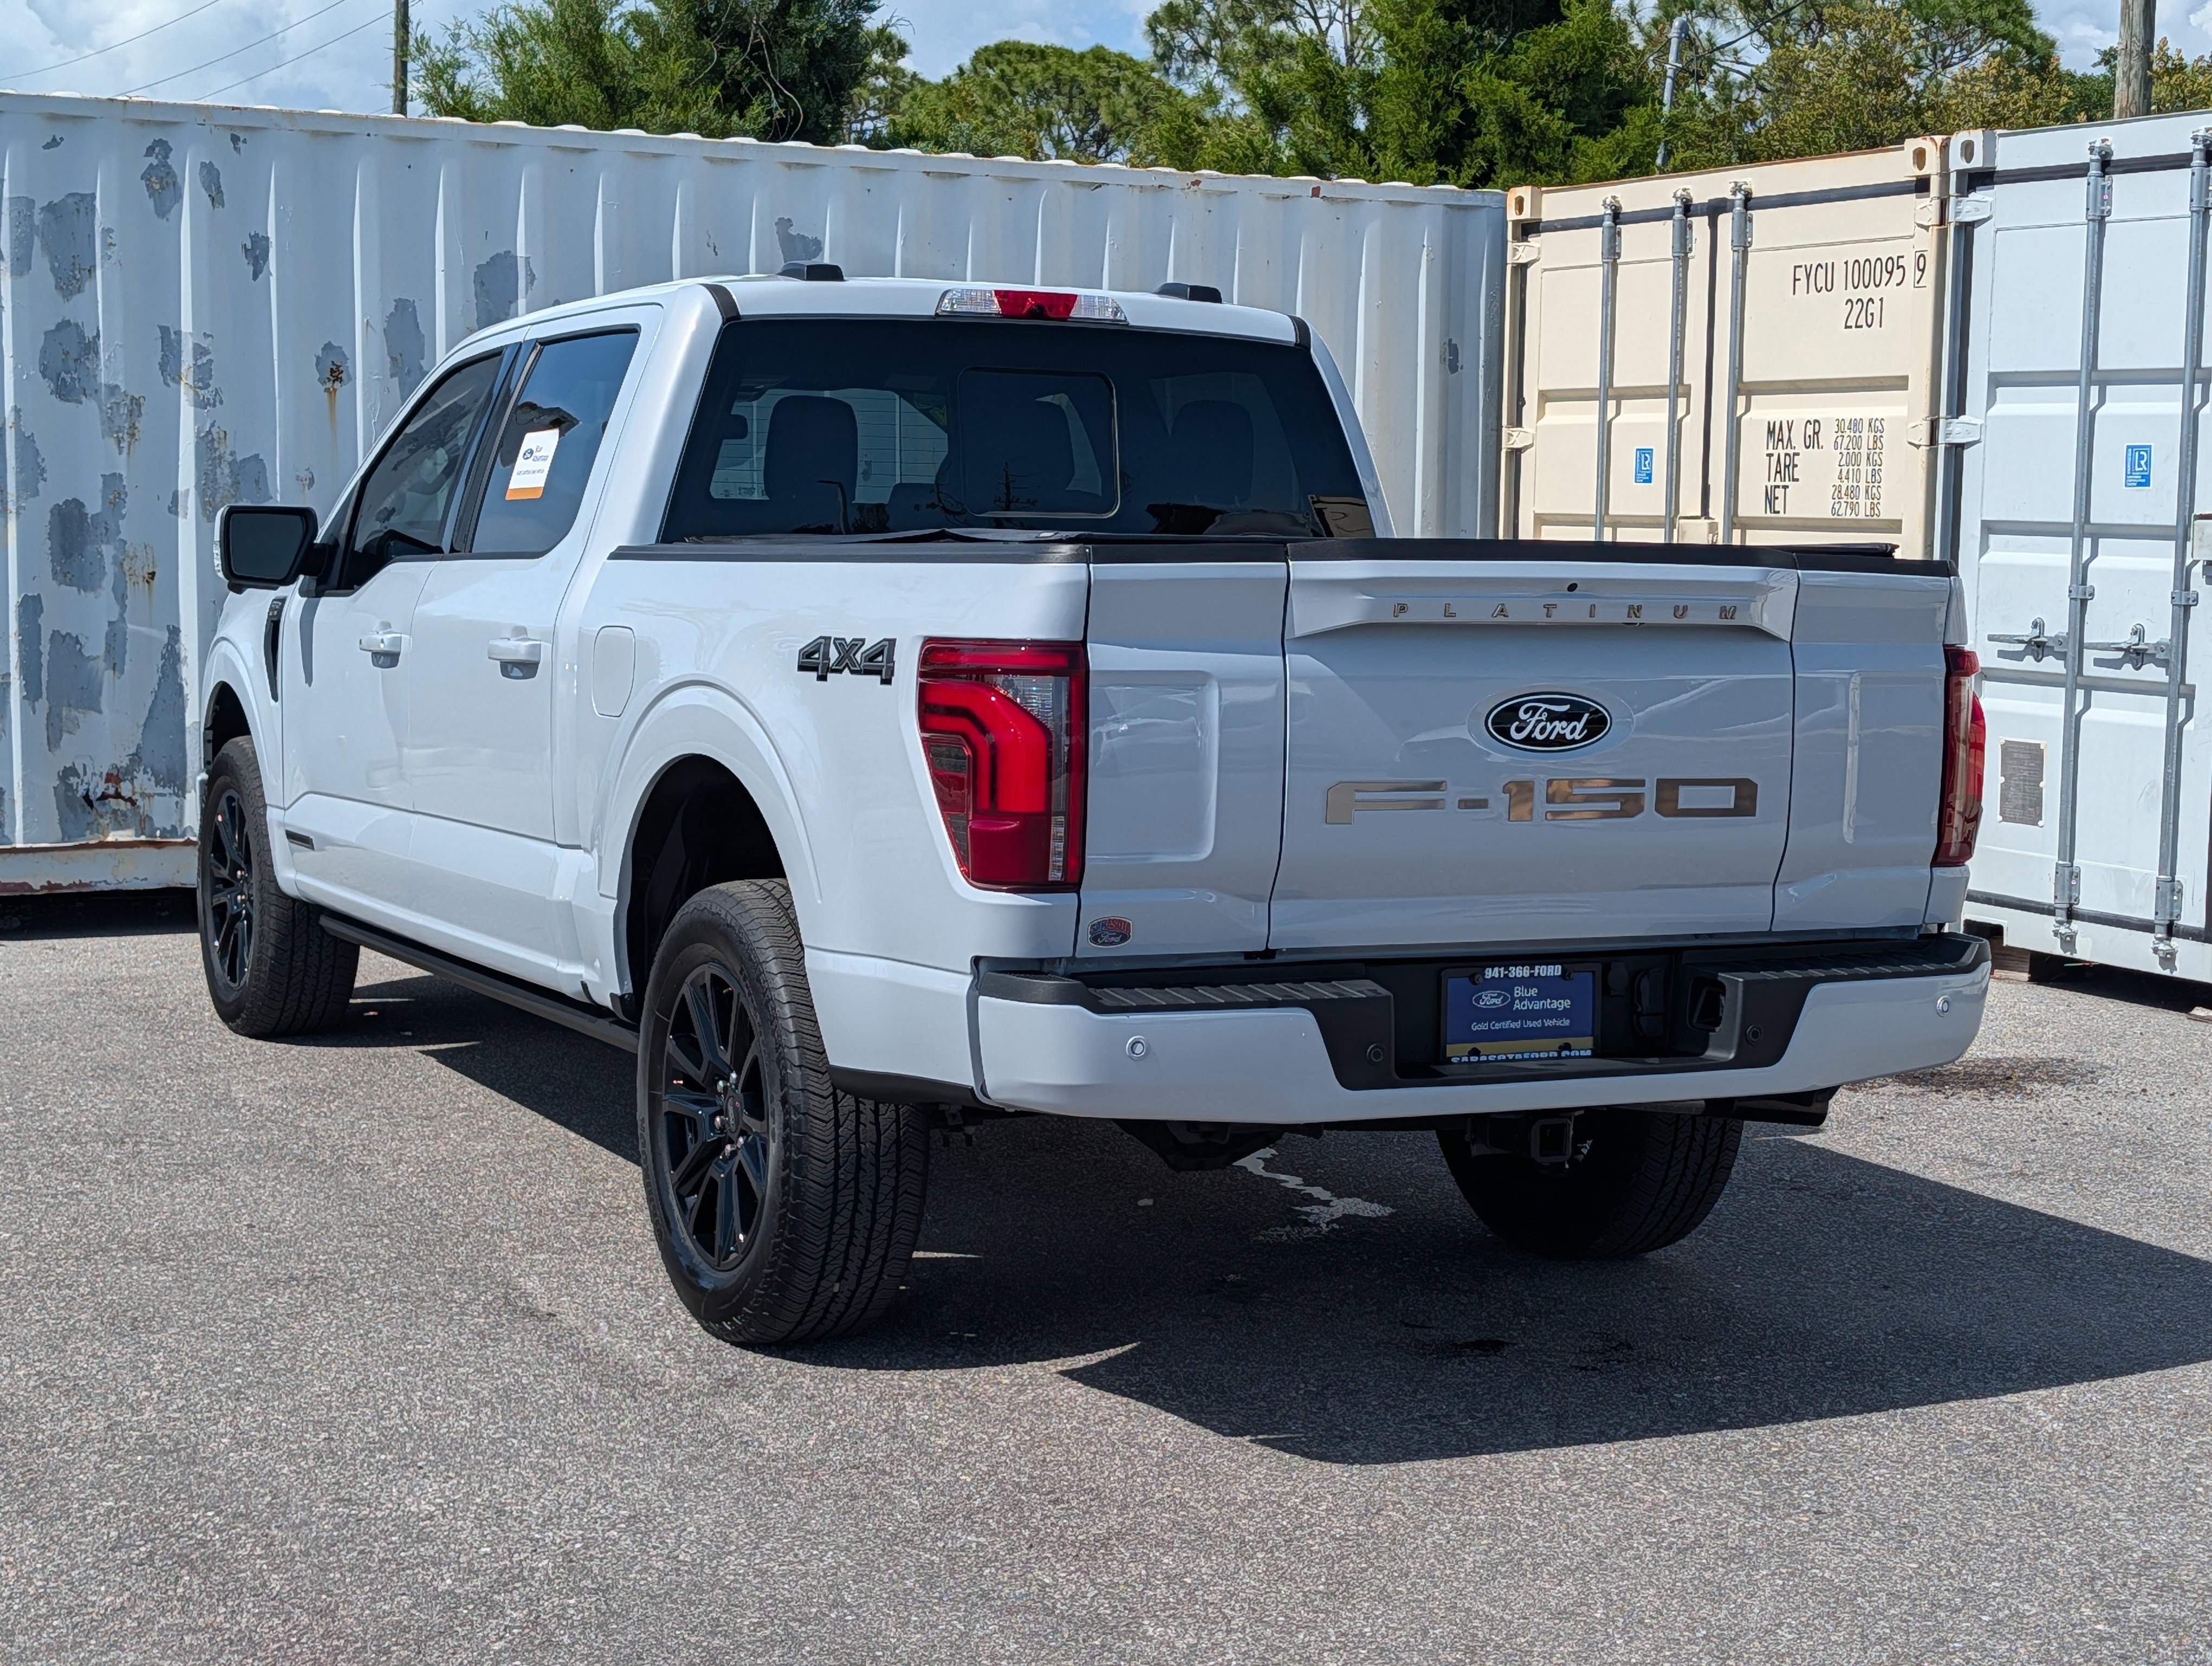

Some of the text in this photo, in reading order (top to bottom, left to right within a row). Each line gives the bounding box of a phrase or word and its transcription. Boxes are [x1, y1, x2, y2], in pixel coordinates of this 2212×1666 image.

[1792, 253, 1926, 296] FYCU 100095 9
[1844, 297, 1884, 329] 22G1
[1804, 419, 1824, 450] GR.
[1868, 418, 1885, 434] KGS
[1867, 435, 1884, 450] LBS
[1766, 452, 1801, 483] TARE
[1866, 452, 1883, 467] KGS
[1865, 468, 1882, 484] LBS
[1765, 485, 1790, 514] NET
[1864, 485, 1882, 501] KGS
[1864, 501, 1881, 517] LBS
[1392, 603, 1738, 620] PLATINUM
[1510, 702, 1589, 741] Ford
[1325, 778, 1758, 825] F-150
[1479, 993, 1504, 1005] Ford
[1513, 985, 1538, 997] Blue
[1513, 998, 1571, 1011] Advantage
[1471, 1021, 1489, 1030] Gold
[1522, 1018, 1542, 1028] Used
